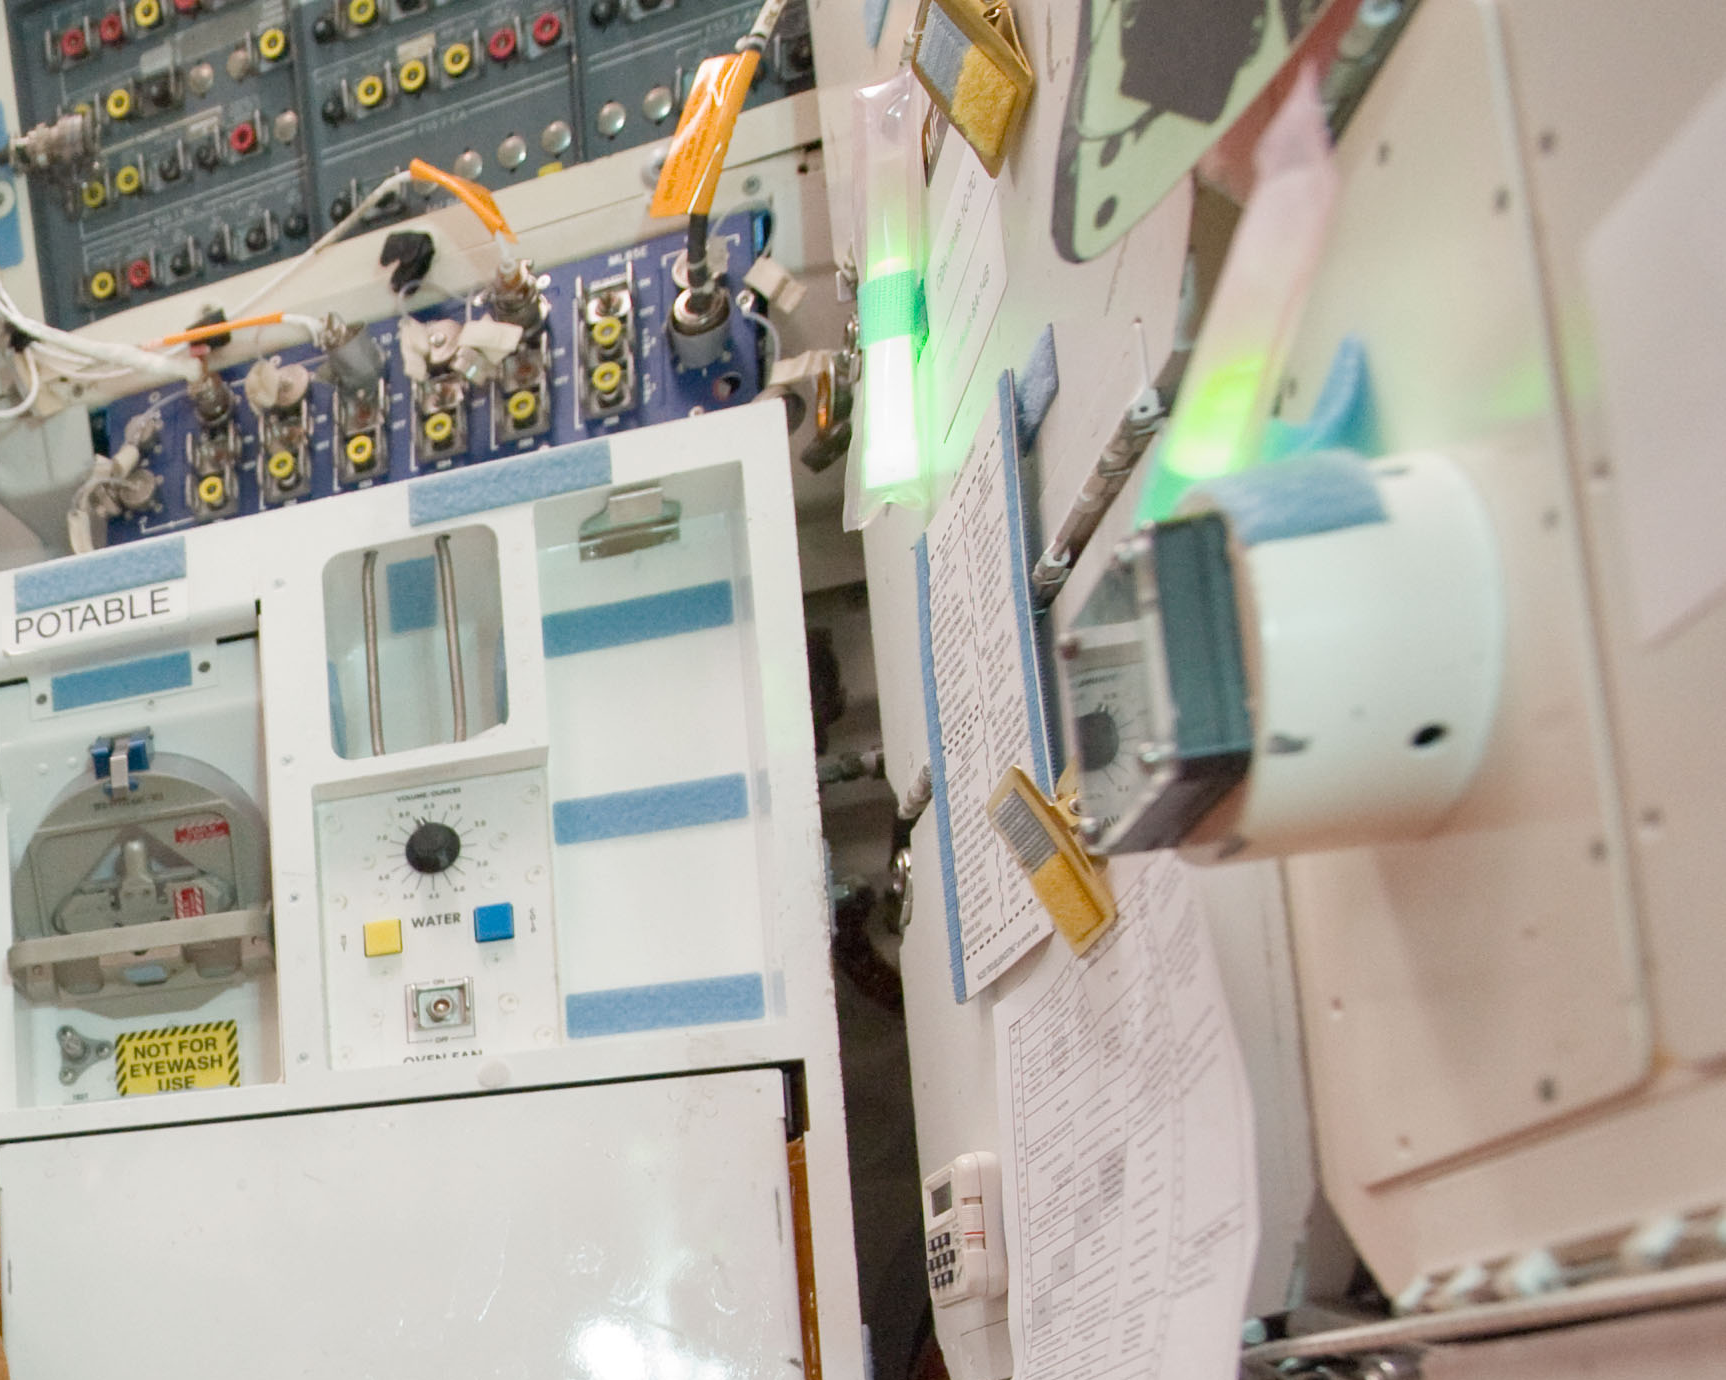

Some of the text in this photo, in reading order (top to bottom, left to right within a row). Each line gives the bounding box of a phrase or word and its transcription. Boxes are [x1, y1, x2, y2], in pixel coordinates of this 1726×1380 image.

[14, 586, 171, 645] POTABLE
[411, 911, 461, 929] WATER
[134, 1037, 217, 1061] NOT FOR
[130, 1054, 223, 1078] EYEWASH
[157, 1076, 196, 1092] USE
